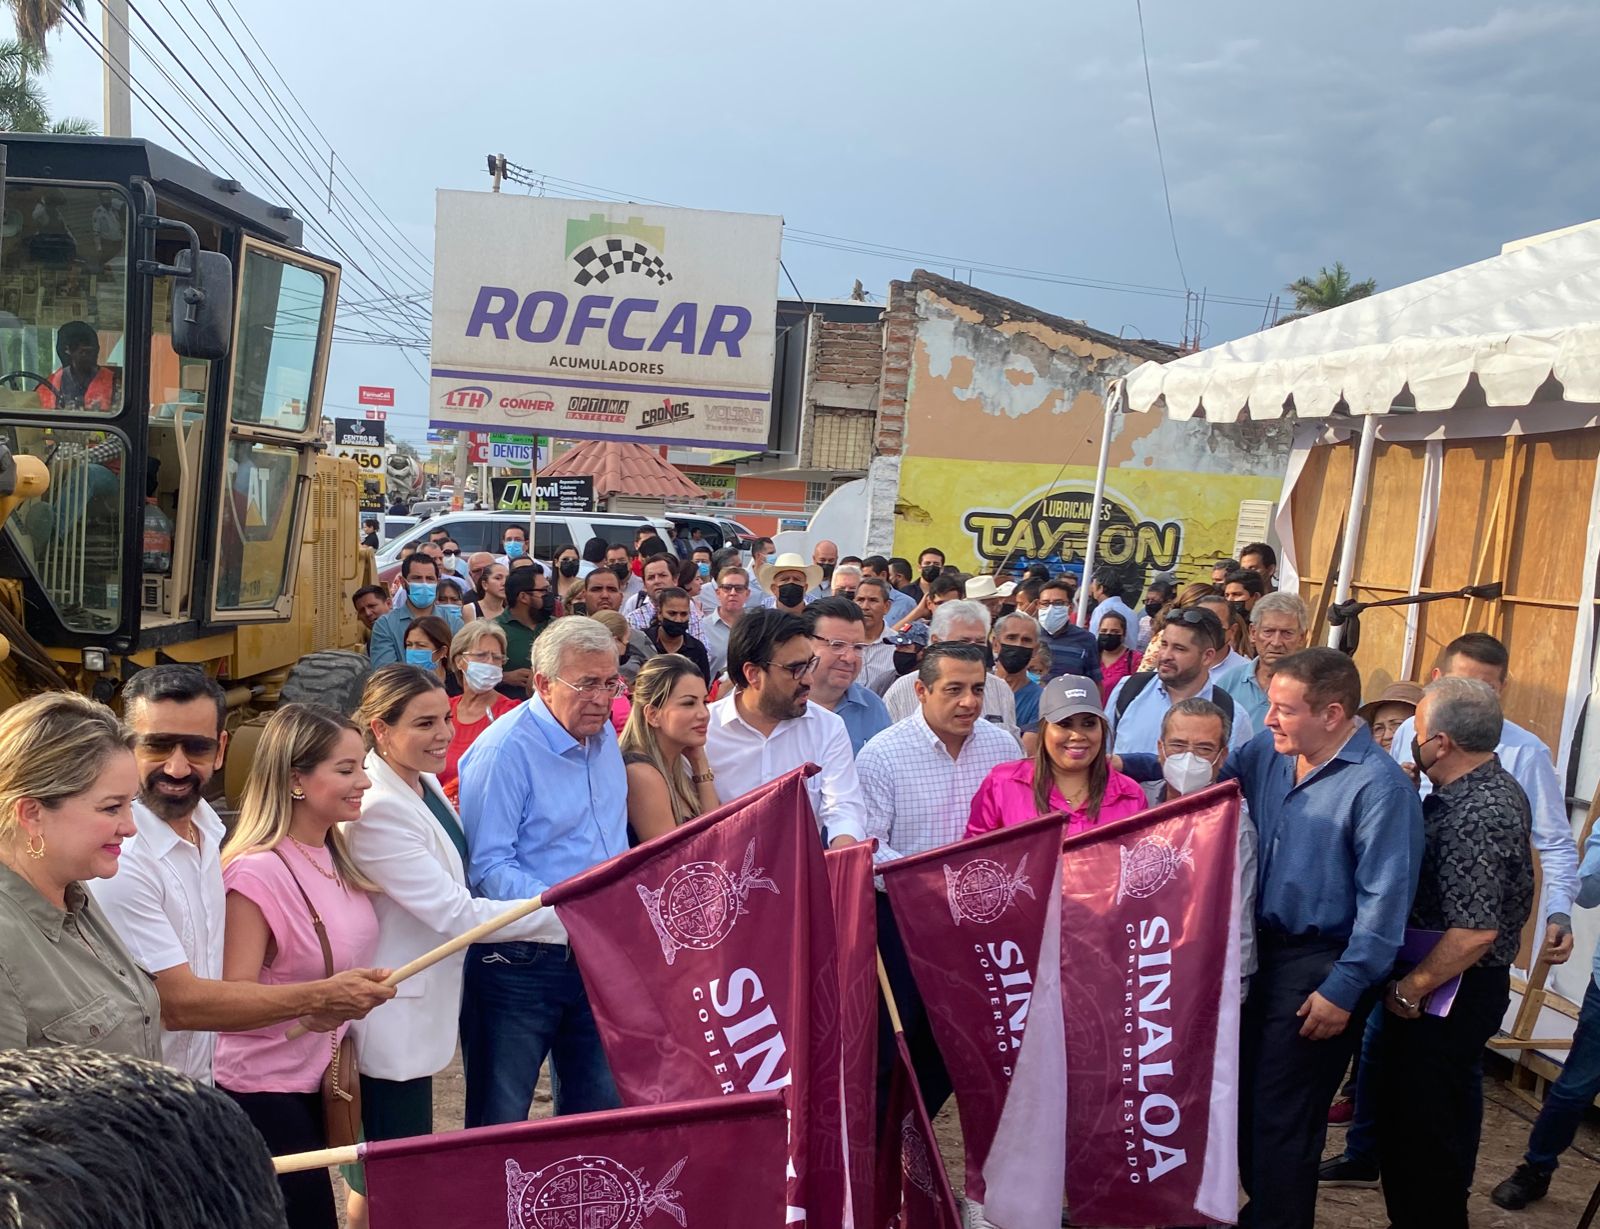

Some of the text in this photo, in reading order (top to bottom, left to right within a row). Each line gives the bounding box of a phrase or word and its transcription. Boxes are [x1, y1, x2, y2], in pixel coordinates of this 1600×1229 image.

[465, 286, 752, 358] ROFCAR
[549, 356, 664, 375] ACUMULADORES
[446, 391, 485, 408] LTH
[499, 397, 555, 412] GONHER
[569, 397, 628, 414] OPTIMA
[567, 412, 625, 423] BATTERIES
[642, 399, 690, 424] CRONOS
[343, 434, 368, 442] CENTRO
[1042, 499, 1112, 521] LUBRICANES
[974, 944, 1008, 1052] GOBIERNO
[692, 986, 735, 1095] GOBIER
[1138, 916, 1187, 1182] SINALOA
[1122, 923, 1141, 1184] GOBIERNO DEL ESTADO
[624, 1181, 637, 1223] SINALOA
